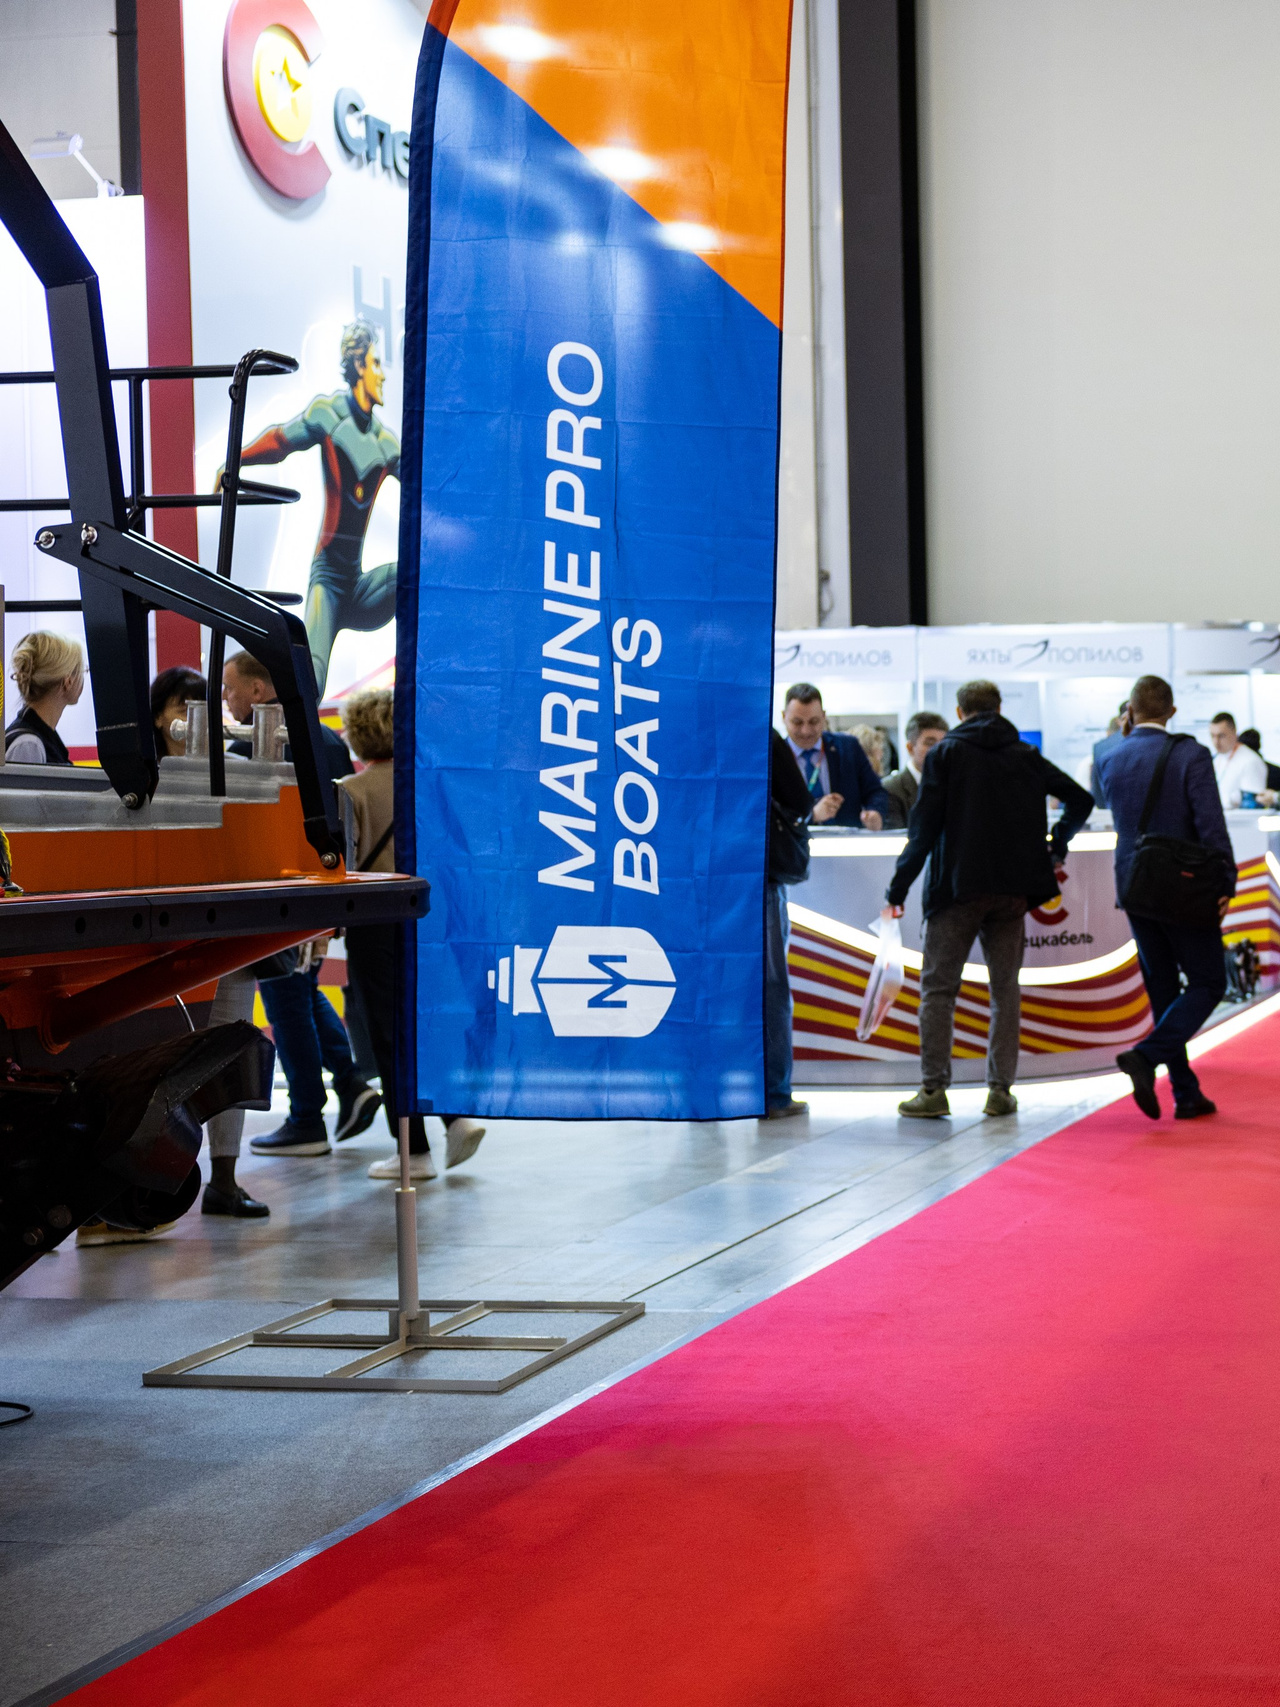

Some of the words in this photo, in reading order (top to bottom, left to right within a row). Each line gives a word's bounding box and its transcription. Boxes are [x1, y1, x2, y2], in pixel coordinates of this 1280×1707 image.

[545, 341, 602, 529] PRO
[537, 541, 601, 893] MARINE
[801, 650, 893, 667] ПОПИЛОВ
[968, 648, 1012, 665] ЯХТЫ
[1048, 646, 1144, 663] ПОПИЛОВ
[612, 616, 663, 896] BOATS
